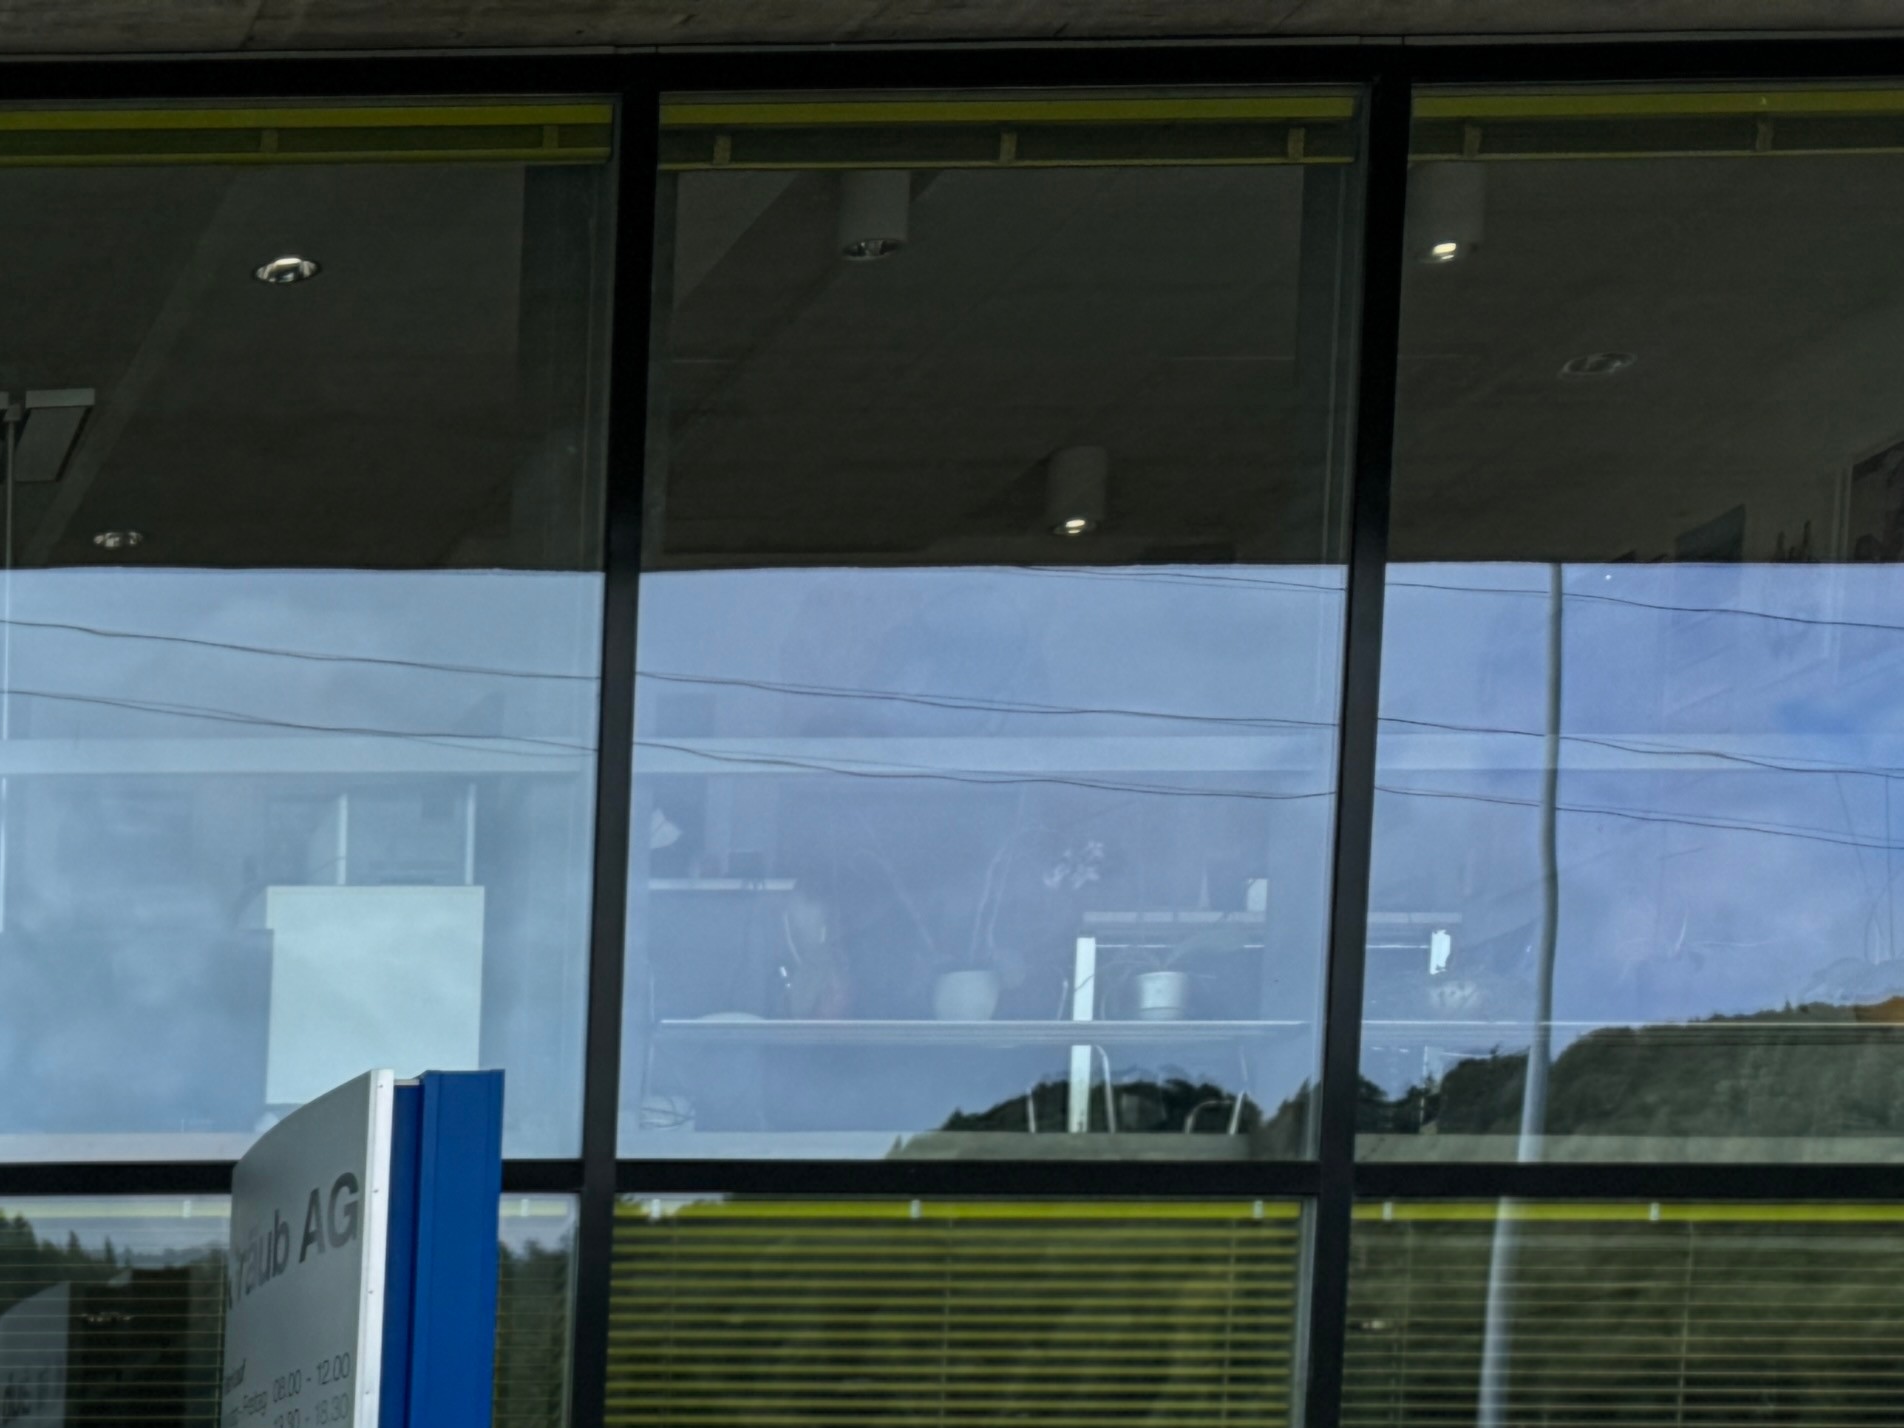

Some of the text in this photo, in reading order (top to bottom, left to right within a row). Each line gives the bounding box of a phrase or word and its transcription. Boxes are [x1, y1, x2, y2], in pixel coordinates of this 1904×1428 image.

[228, 1172, 359, 1309] räub AG
[317, 1352, 350, 1385] 12.00
